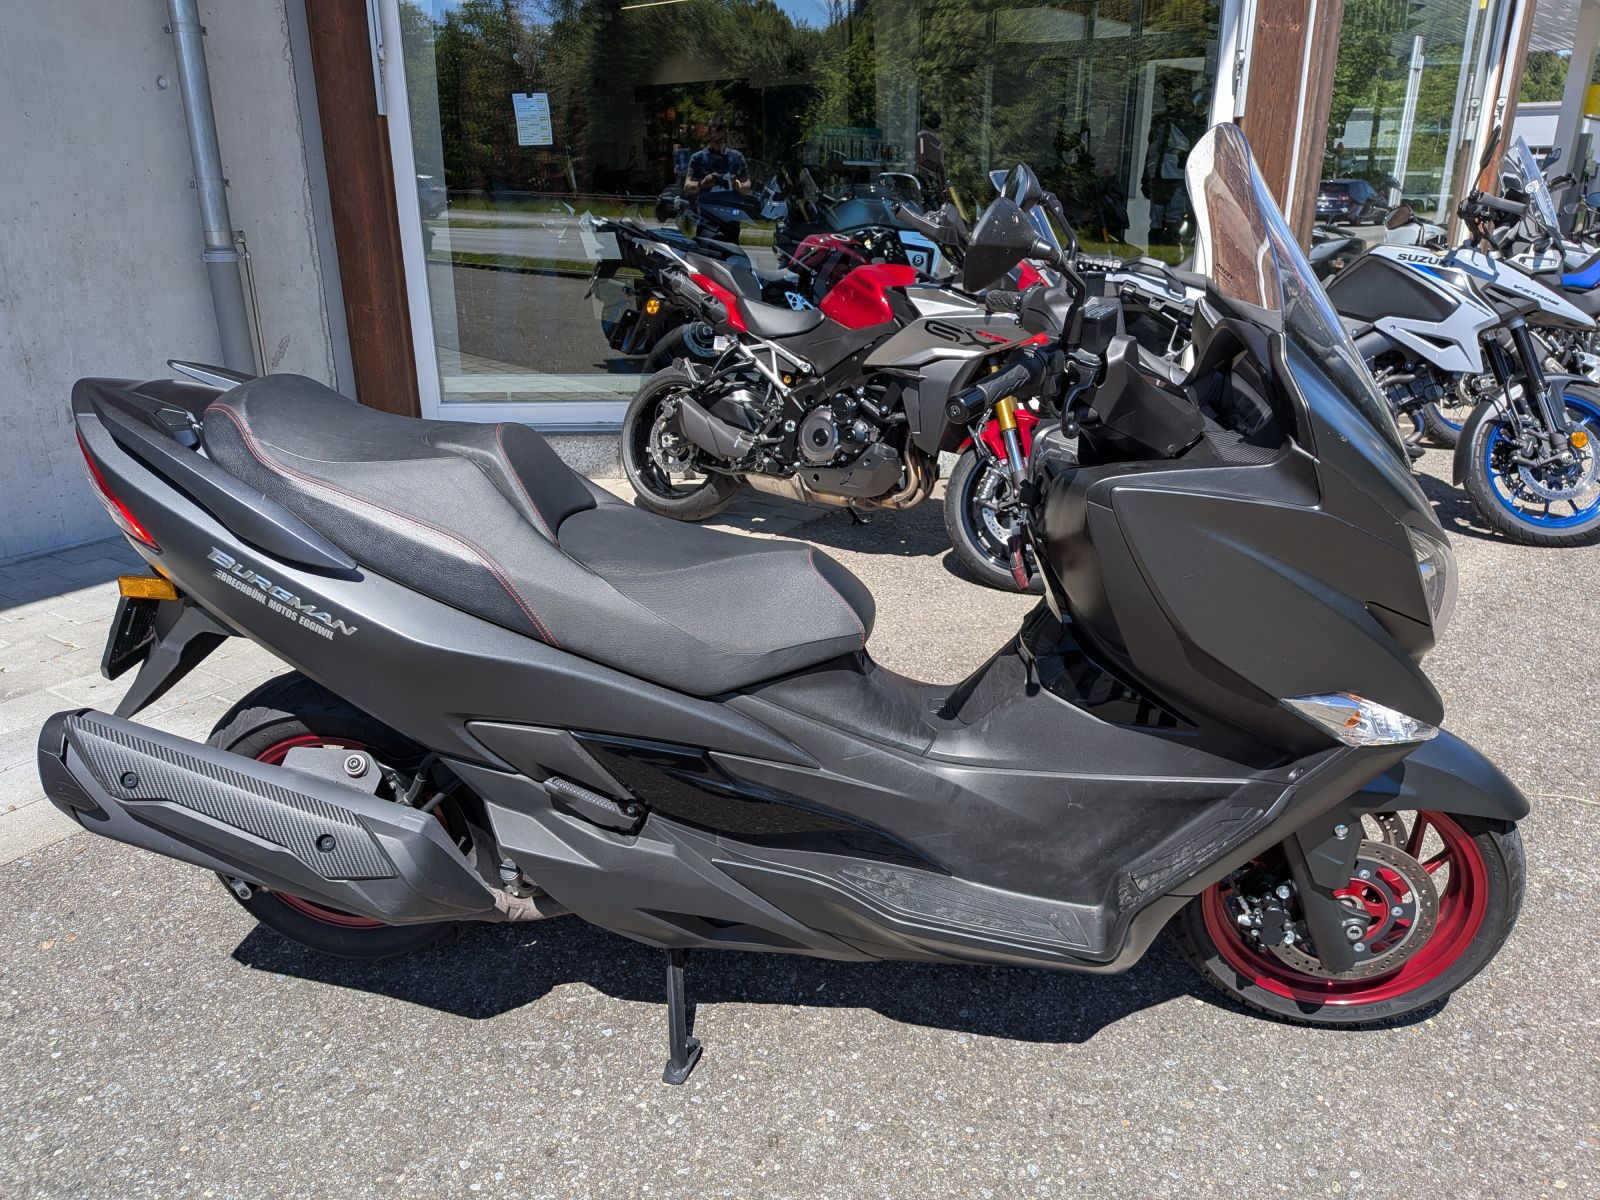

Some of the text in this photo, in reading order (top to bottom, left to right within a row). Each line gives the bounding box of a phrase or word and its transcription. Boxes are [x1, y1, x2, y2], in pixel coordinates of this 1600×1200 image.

[915, 255, 922, 263] 8
[1397, 253, 1454, 267] SUZUKI
[207, 546, 358, 636] BURGMAN
[219, 571, 334, 641] BRECHBÜHL MOTOS EGGIWIL
